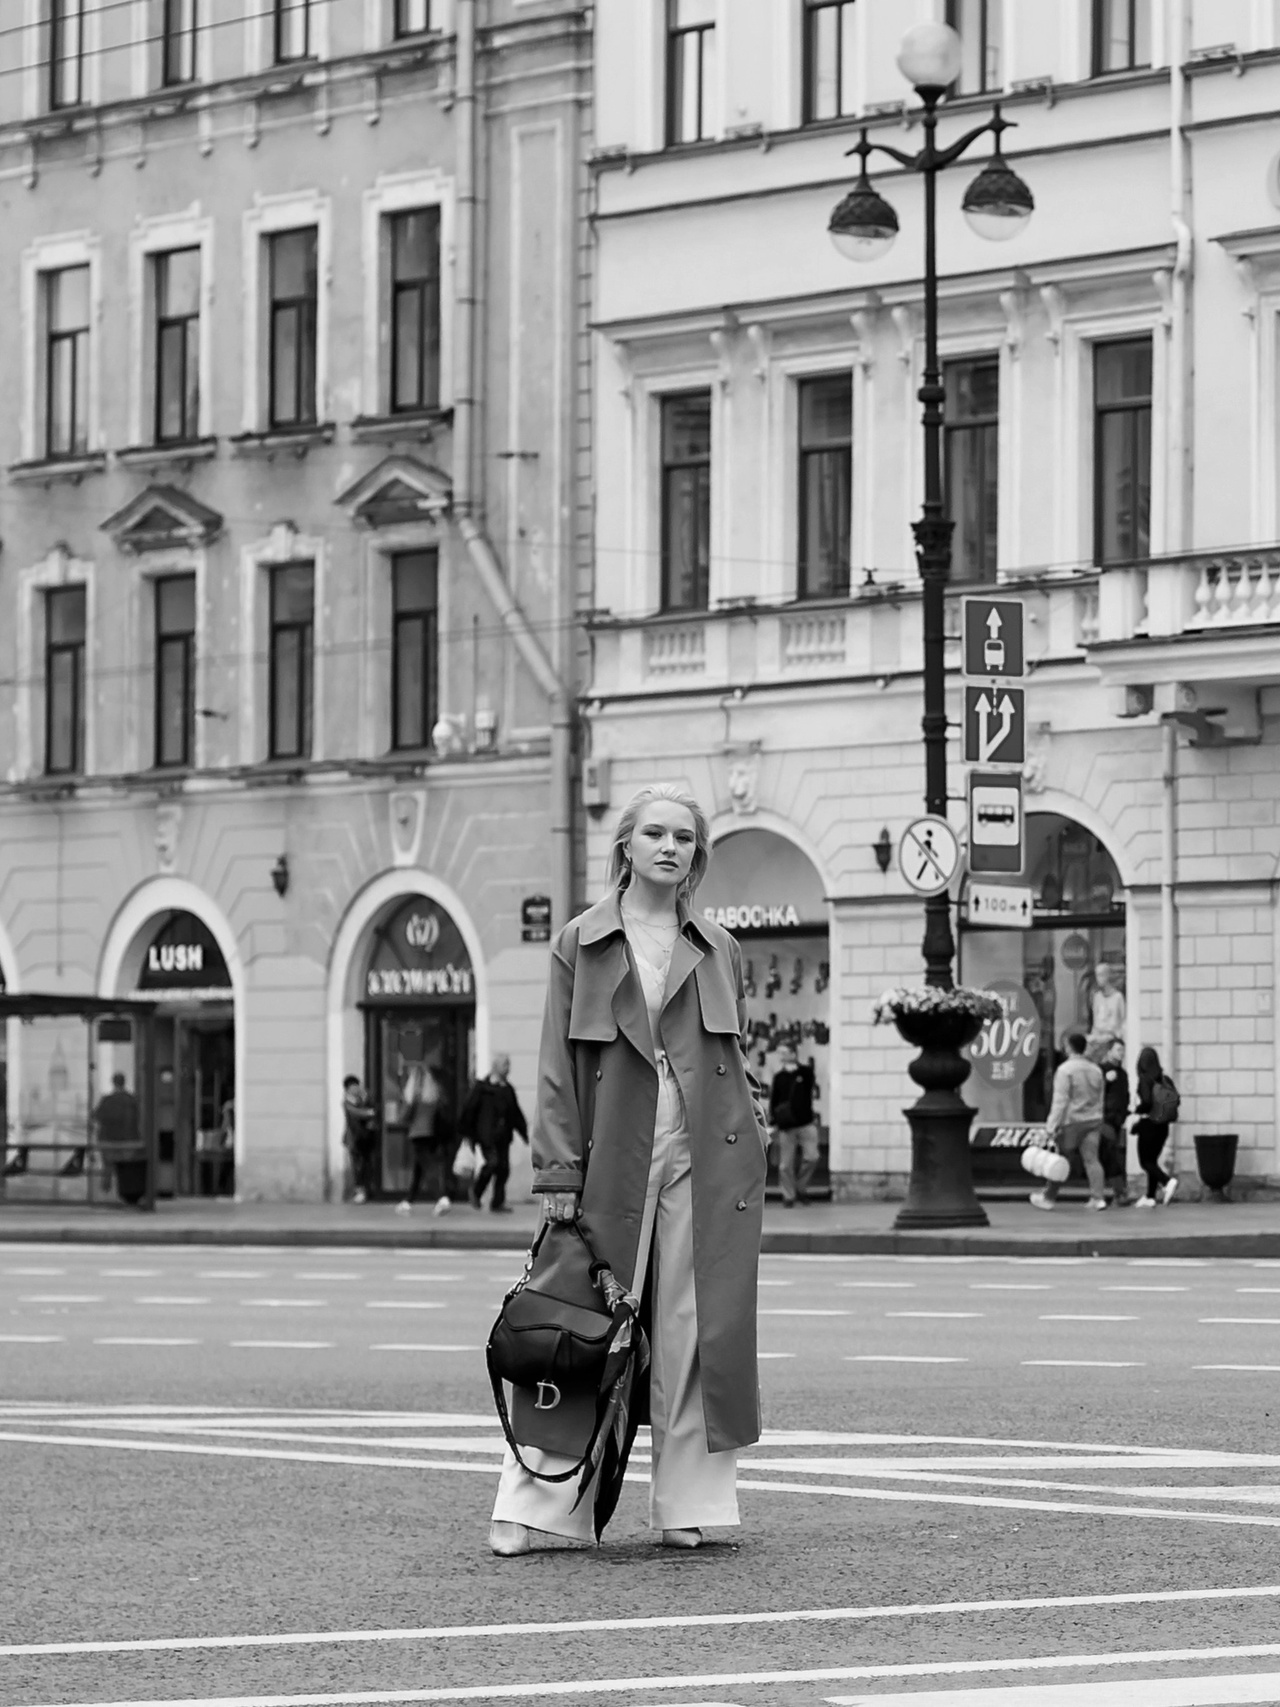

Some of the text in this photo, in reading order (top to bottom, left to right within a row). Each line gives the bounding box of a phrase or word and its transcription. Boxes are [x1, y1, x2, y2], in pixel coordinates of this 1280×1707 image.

[984, 898, 1007, 912] 100
[149, 943, 203, 972] LUSH
[970, 1016, 1038, 1058] 50%
[534, 1381, 561, 1410] D
